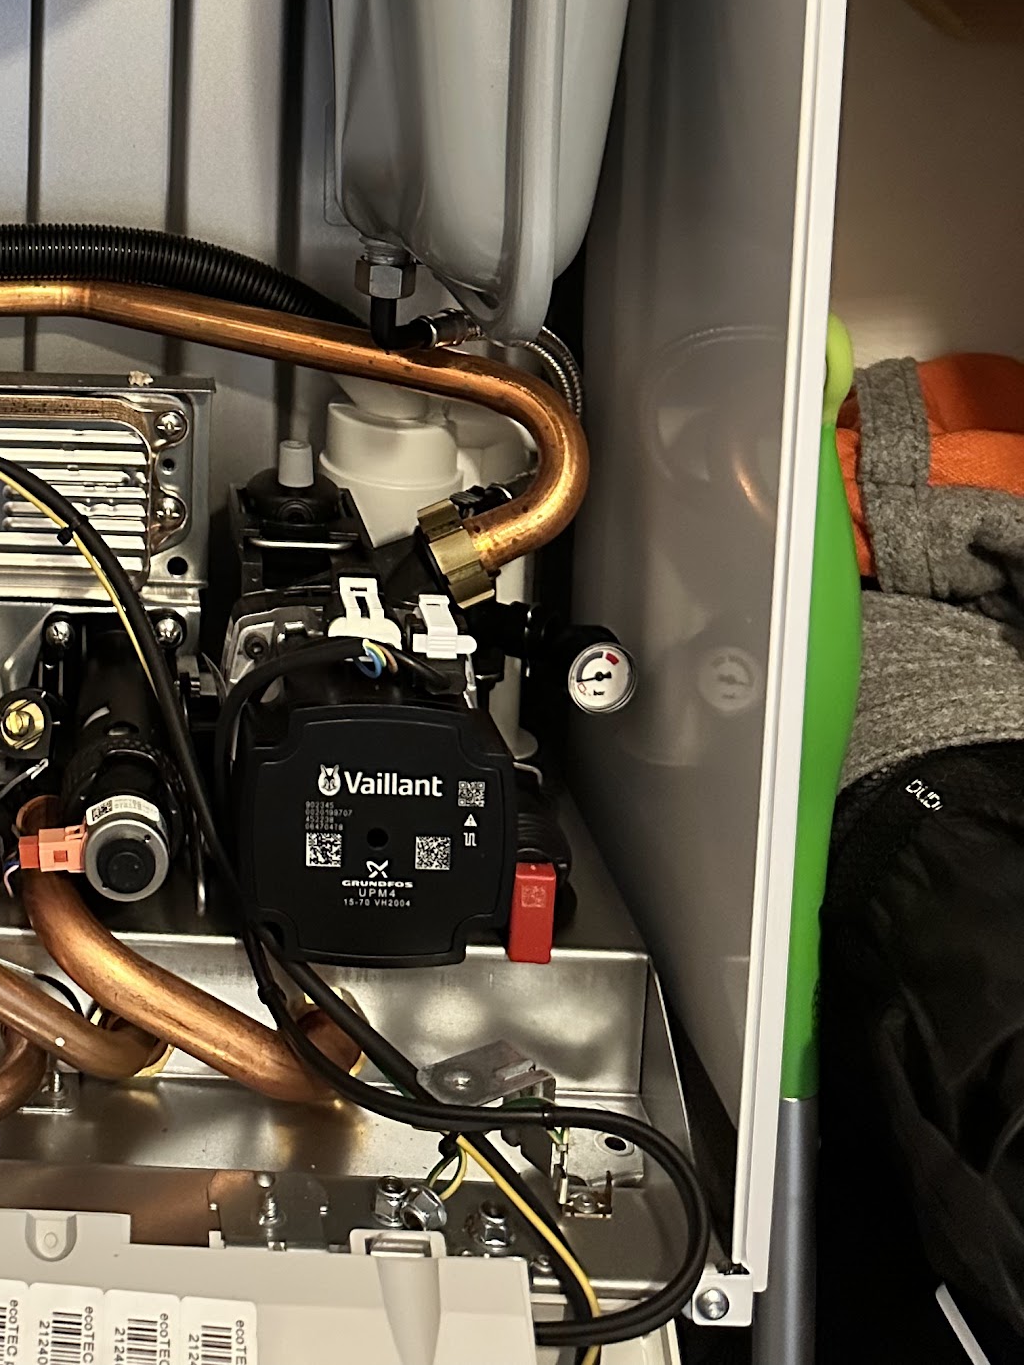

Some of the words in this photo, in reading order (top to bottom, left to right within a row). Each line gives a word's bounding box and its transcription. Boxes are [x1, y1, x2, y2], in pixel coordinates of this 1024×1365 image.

[344, 771, 443, 797] Vaillant
[341, 879, 414, 888] GRUNDFOS
[358, 888, 396, 897] UPM4
[343, 898, 370, 906] 15-70
[373, 898, 411, 907] VH2004
[6, 1299, 19, 1357] ecoTEC
[37, 1320, 50, 1365] 21240
[82, 1306, 95, 1364] ecoTEC
[114, 1327, 126, 1365] 2124
